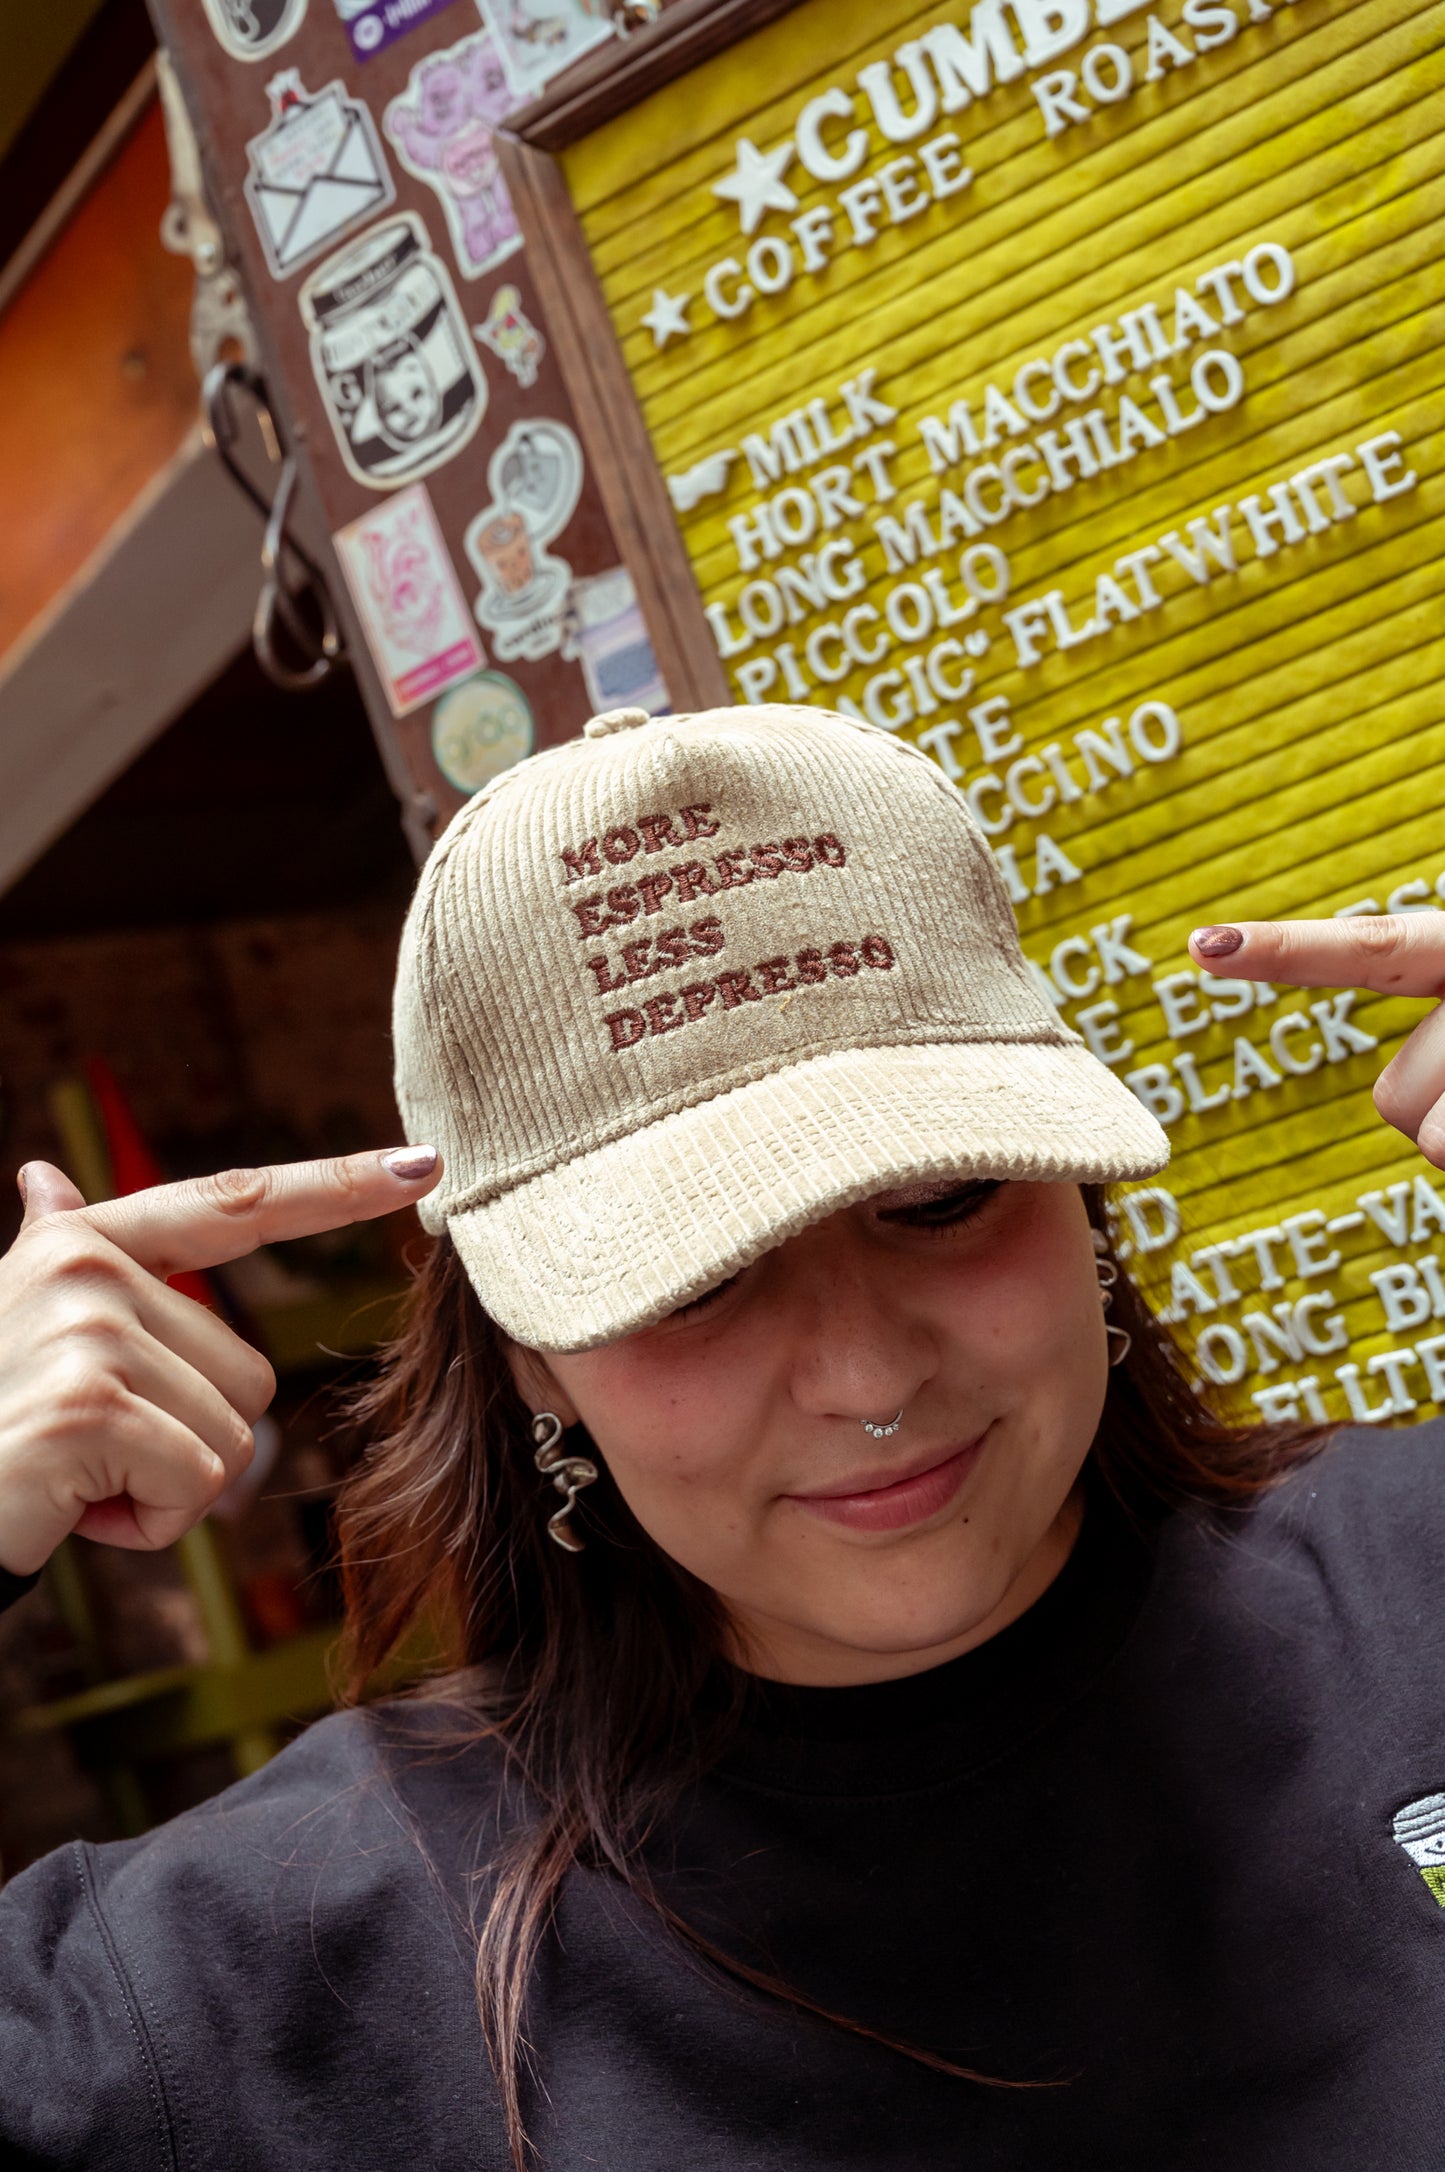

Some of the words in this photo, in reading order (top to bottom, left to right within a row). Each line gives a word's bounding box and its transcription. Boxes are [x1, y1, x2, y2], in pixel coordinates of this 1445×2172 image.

[703, 133, 974, 320] COFFEE
[1030, 0, 1272, 138] ROAS
[796, 0, 1151, 182] CUMB
[727, 441, 900, 573] HORT
[916, 242, 1295, 475] MACCHIATO
[743, 367, 898, 490] MILK
[705, 538, 867, 659] LONG
[873, 350, 1245, 575] MACCHIALO
[1003, 430, 1418, 670] FLATWHITE
[734, 542, 1011, 707] PICCOLO
[559, 803, 721, 885] MORE
[572, 833, 847, 940] ESPRESSO
[587, 916, 725, 997] LESS
[604, 935, 895, 1052] DEPRESSO
[1123, 990, 1378, 1125] BLACK
